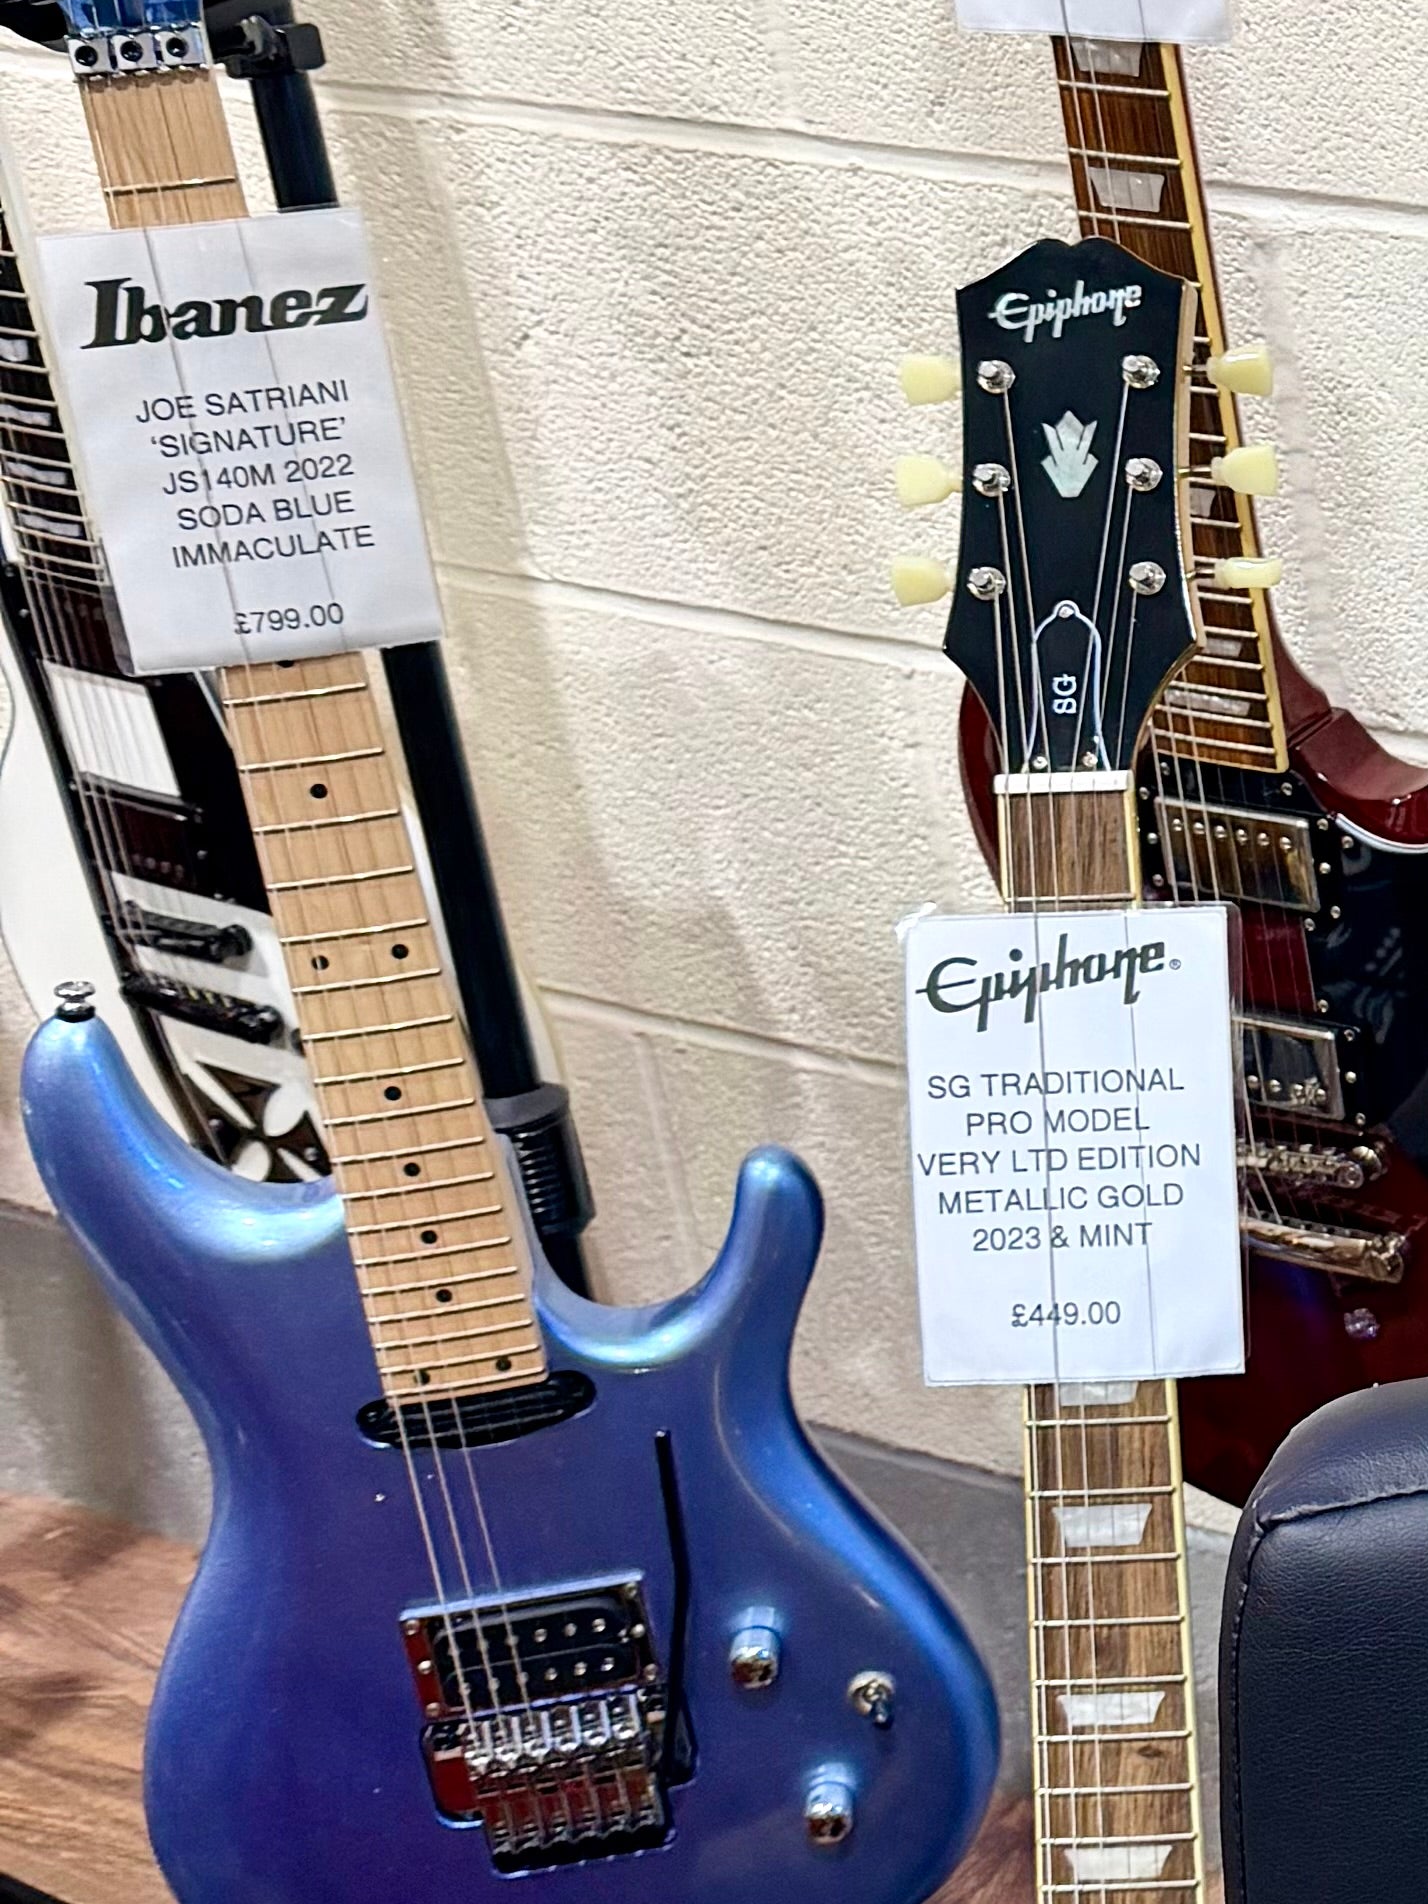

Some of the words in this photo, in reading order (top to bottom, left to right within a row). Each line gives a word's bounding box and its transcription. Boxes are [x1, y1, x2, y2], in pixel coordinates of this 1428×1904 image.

[80, 277, 370, 350] Ibanez
[987, 279, 1143, 343] Epiphone
[135, 395, 198, 424] JOE
[205, 379, 350, 417] SATRIANI
[162, 463, 276, 496] JS140M
[284, 453, 355, 483] 2022
[177, 504, 266, 531] SODA
[274, 490, 356, 521] BLUE
[171, 524, 376, 569] IMMACULATE
[233, 601, 344, 635] £799.00
[1052, 673, 1077, 715] SG
[914, 932, 1167, 1033] Epiphone
[927, 1074, 971, 1100] SG
[980, 1067, 1186, 1097] TRADITIONAL
[965, 1111, 1033, 1137] PRO
[1044, 1107, 1151, 1134] MODEL
[917, 1151, 1001, 1177] VERY
[1011, 1148, 1068, 1173] LTD
[1078, 1143, 1201, 1171] EDITION
[938, 1185, 1088, 1215] METALLIC
[1097, 1181, 1185, 1209] GOLD
[972, 1226, 1041, 1253] 2023
[1049, 1225, 1071, 1249] &
[1079, 1221, 1153, 1248] MINT
[1010, 1300, 1121, 1328] £449.00
